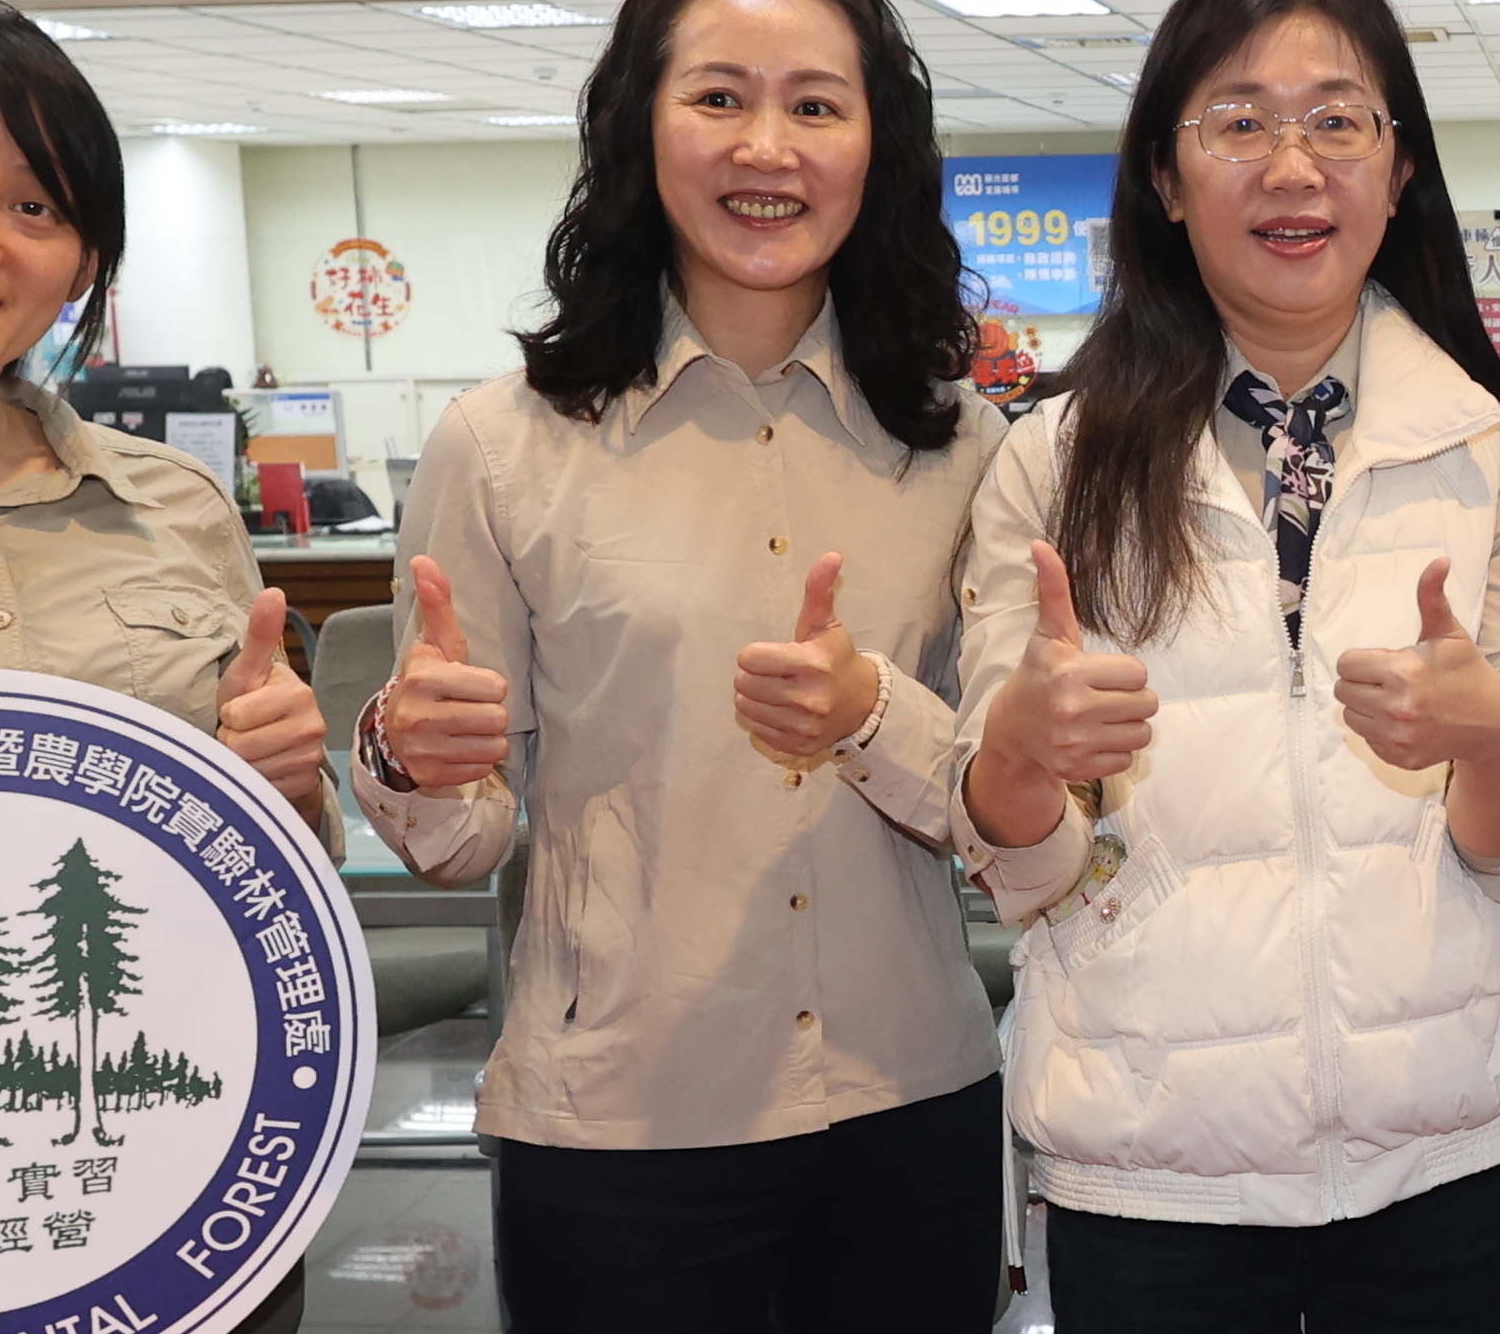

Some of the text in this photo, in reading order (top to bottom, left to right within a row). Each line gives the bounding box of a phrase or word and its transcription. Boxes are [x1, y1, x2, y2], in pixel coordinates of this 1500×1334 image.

[968, 208, 1071, 247] 1999
[7, 1156, 122, 1204] 實習
[174, 1113, 302, 1282] FOREST
